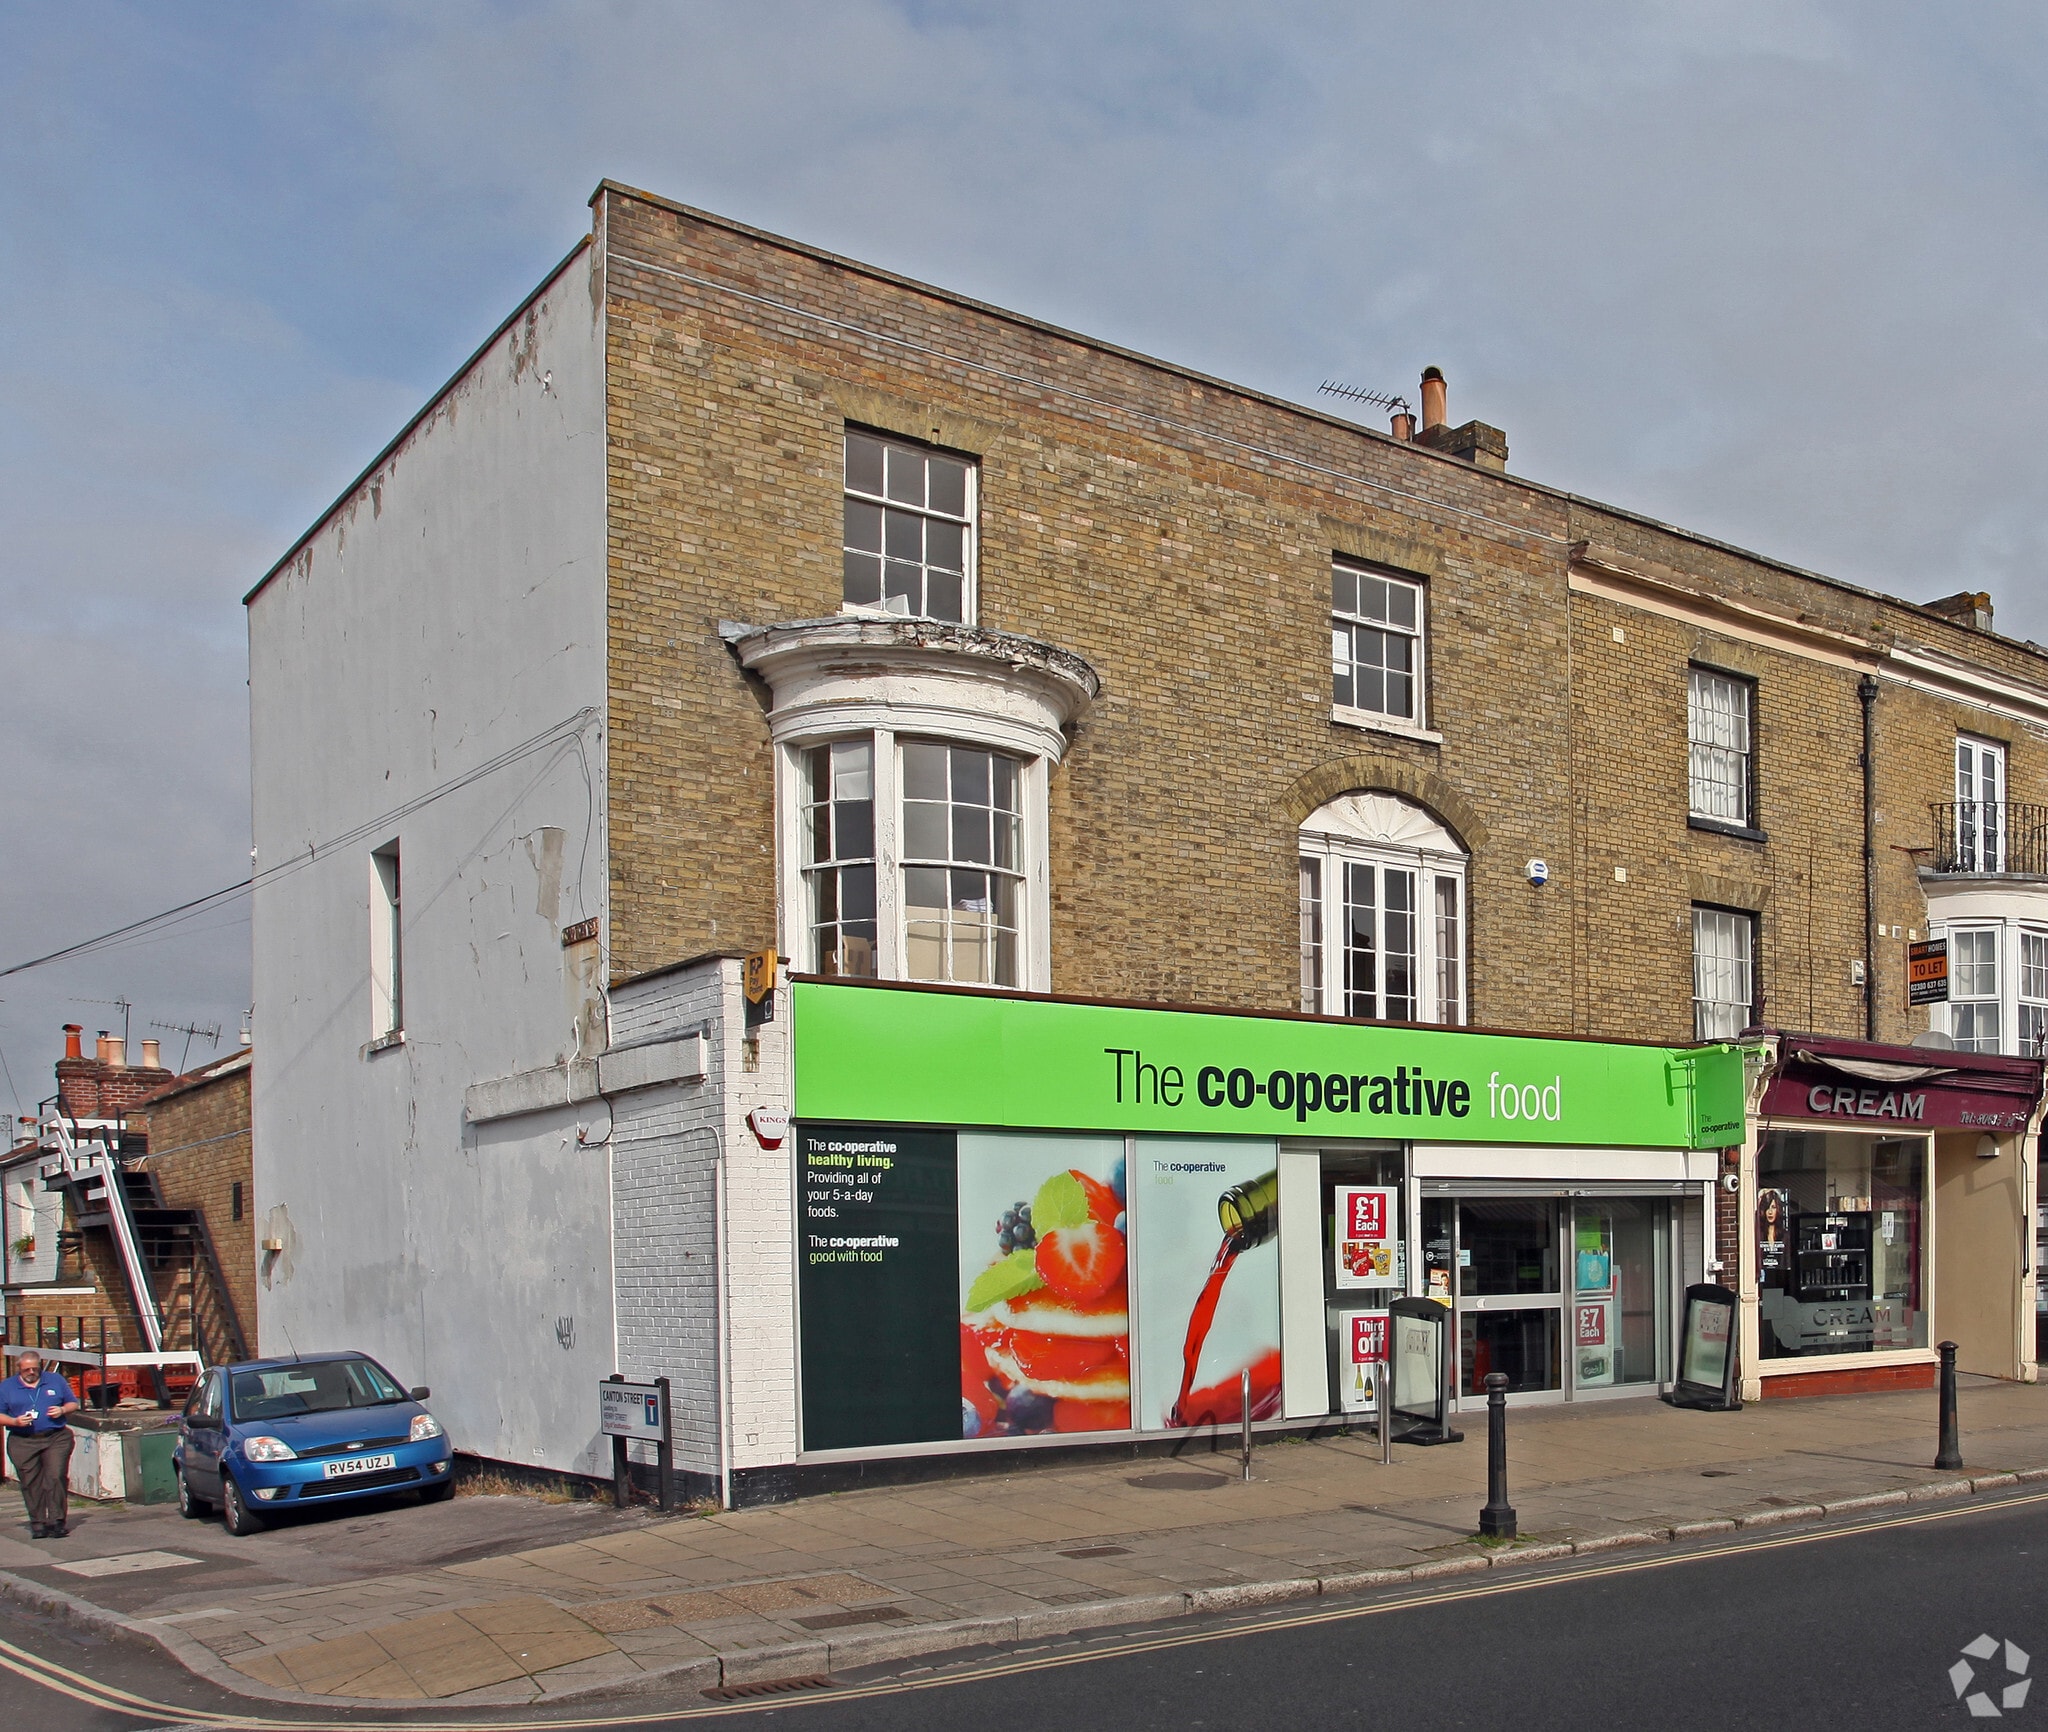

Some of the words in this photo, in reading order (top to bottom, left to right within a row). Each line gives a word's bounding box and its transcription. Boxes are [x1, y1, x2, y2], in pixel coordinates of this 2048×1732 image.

[1914, 964, 1926, 977] TO
[1928, 961, 1944, 975] LET
[1104, 1048, 1184, 1107] The
[1197, 1065, 1471, 1123] co-operative
[1487, 1071, 1562, 1121] food
[1808, 1084, 1927, 1119] CREAM
[759, 1116, 787, 1124] KINGS
[1701, 1114, 1712, 1123] The
[1701, 1120, 1740, 1133] co-operative
[807, 1138, 826, 1152] The
[828, 1140, 897, 1154] co-operative
[1702, 1135, 1715, 1145] food
[807, 1153, 854, 1169] healthy
[856, 1154, 895, 1170] living.
[1153, 1160, 1169, 1172] The
[1170, 1161, 1226, 1174] co-operative
[807, 1171, 855, 1186] Providing
[857, 1172, 869, 1184] all
[871, 1172, 882, 1184] of
[1155, 1174, 1174, 1185] food
[807, 1190, 831, 1203] your
[832, 1188, 874, 1203] 5-a-day
[807, 1205, 840, 1218] foods.
[1355, 1196, 1379, 1220] £1
[1355, 1219, 1379, 1231] Each
[808, 1234, 828, 1248] The
[829, 1235, 900, 1250] co-operative
[809, 1250, 836, 1265] good
[837, 1250, 859, 1262] with
[860, 1249, 883, 1262] food
[1580, 1308, 1600, 1328] £7
[1812, 1306, 1890, 1327] CREAM
[1358, 1320, 1385, 1332] Third
[1580, 1326, 1600, 1338] Each
[1358, 1332, 1385, 1354] off
[1813, 1336, 1845, 1344] HAIR
[603, 1390, 623, 1403] CANTON
[624, 1391, 644, 1405] STREET
[330, 1460, 363, 1475] RV54
[366, 1455, 391, 1470] UZJ
